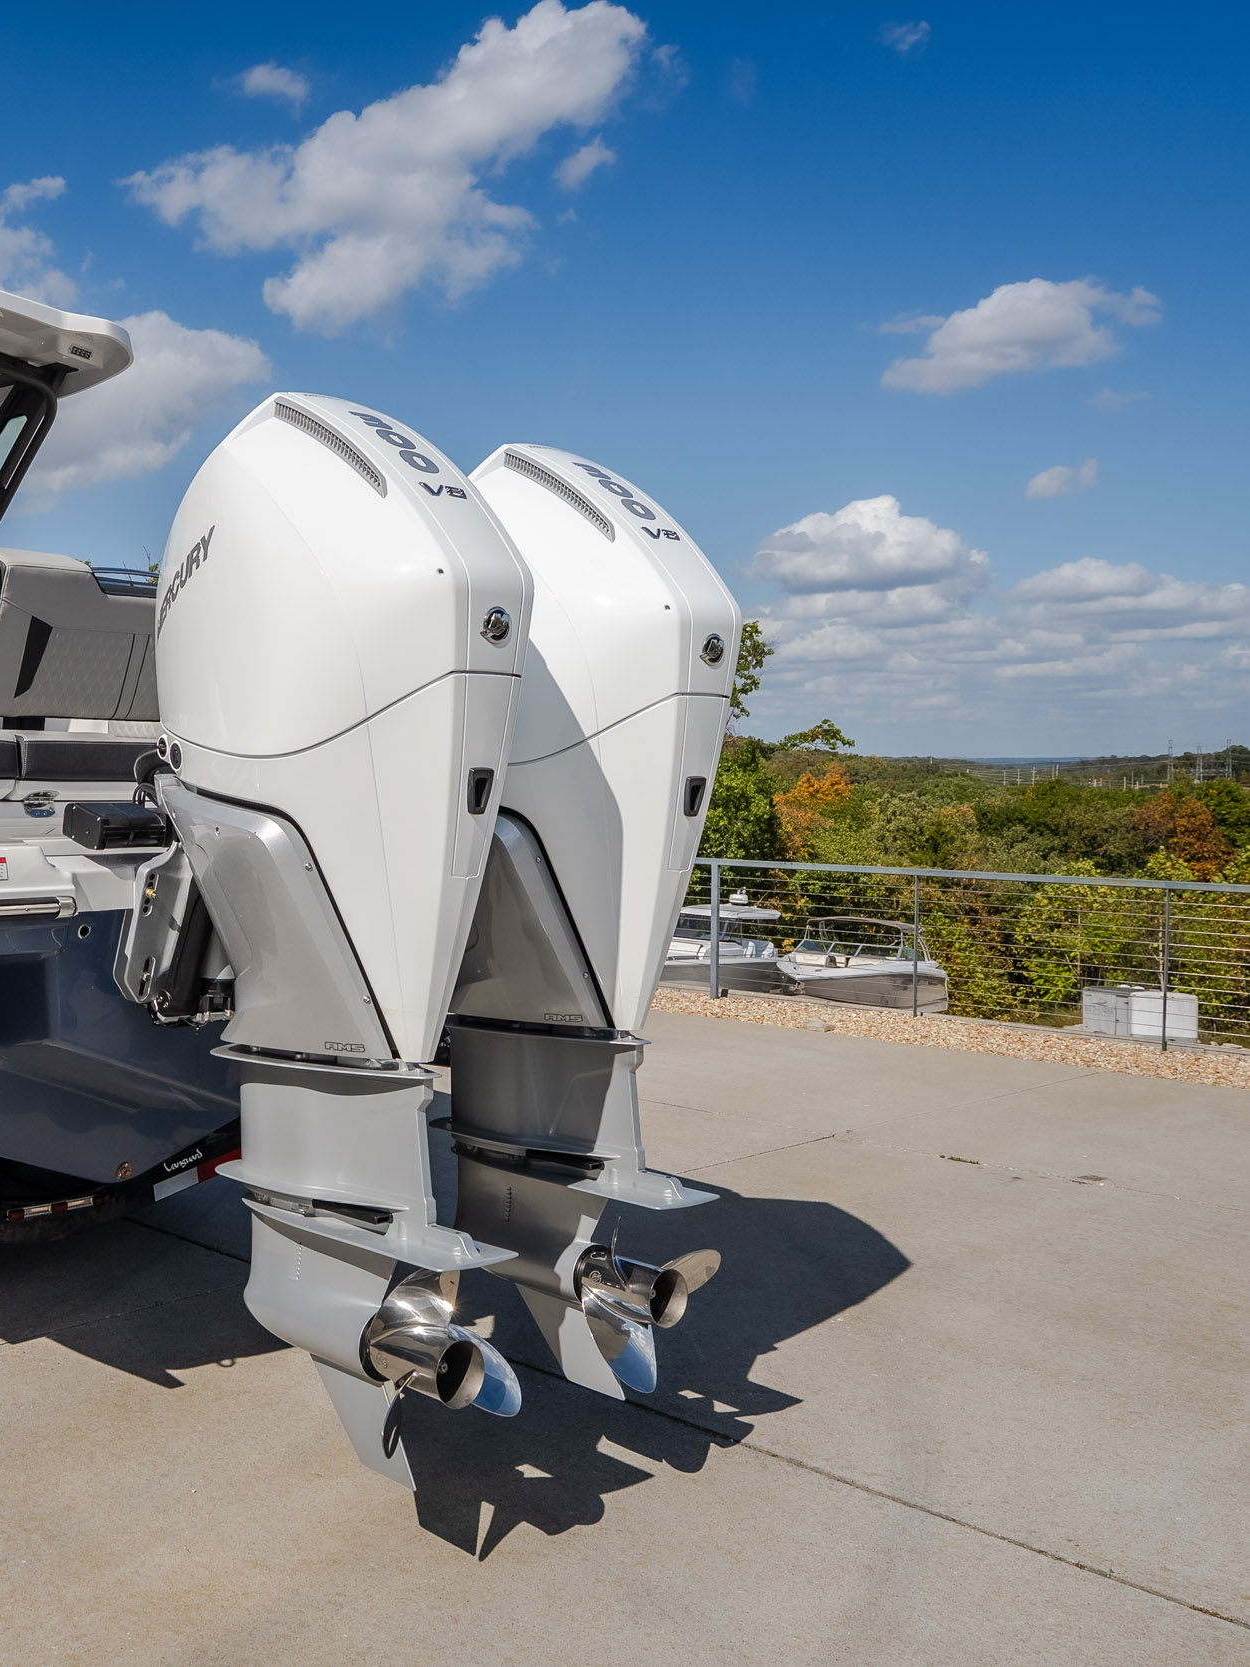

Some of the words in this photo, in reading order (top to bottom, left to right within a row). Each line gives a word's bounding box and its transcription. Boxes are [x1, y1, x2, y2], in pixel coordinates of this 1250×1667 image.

[348, 411, 440, 474] 300
[418, 481, 468, 500] V8
[571, 461, 656, 521] 300
[640, 526, 681, 542] V8
[543, 1012, 584, 1023] AMS
[324, 1041, 366, 1053] AMS
